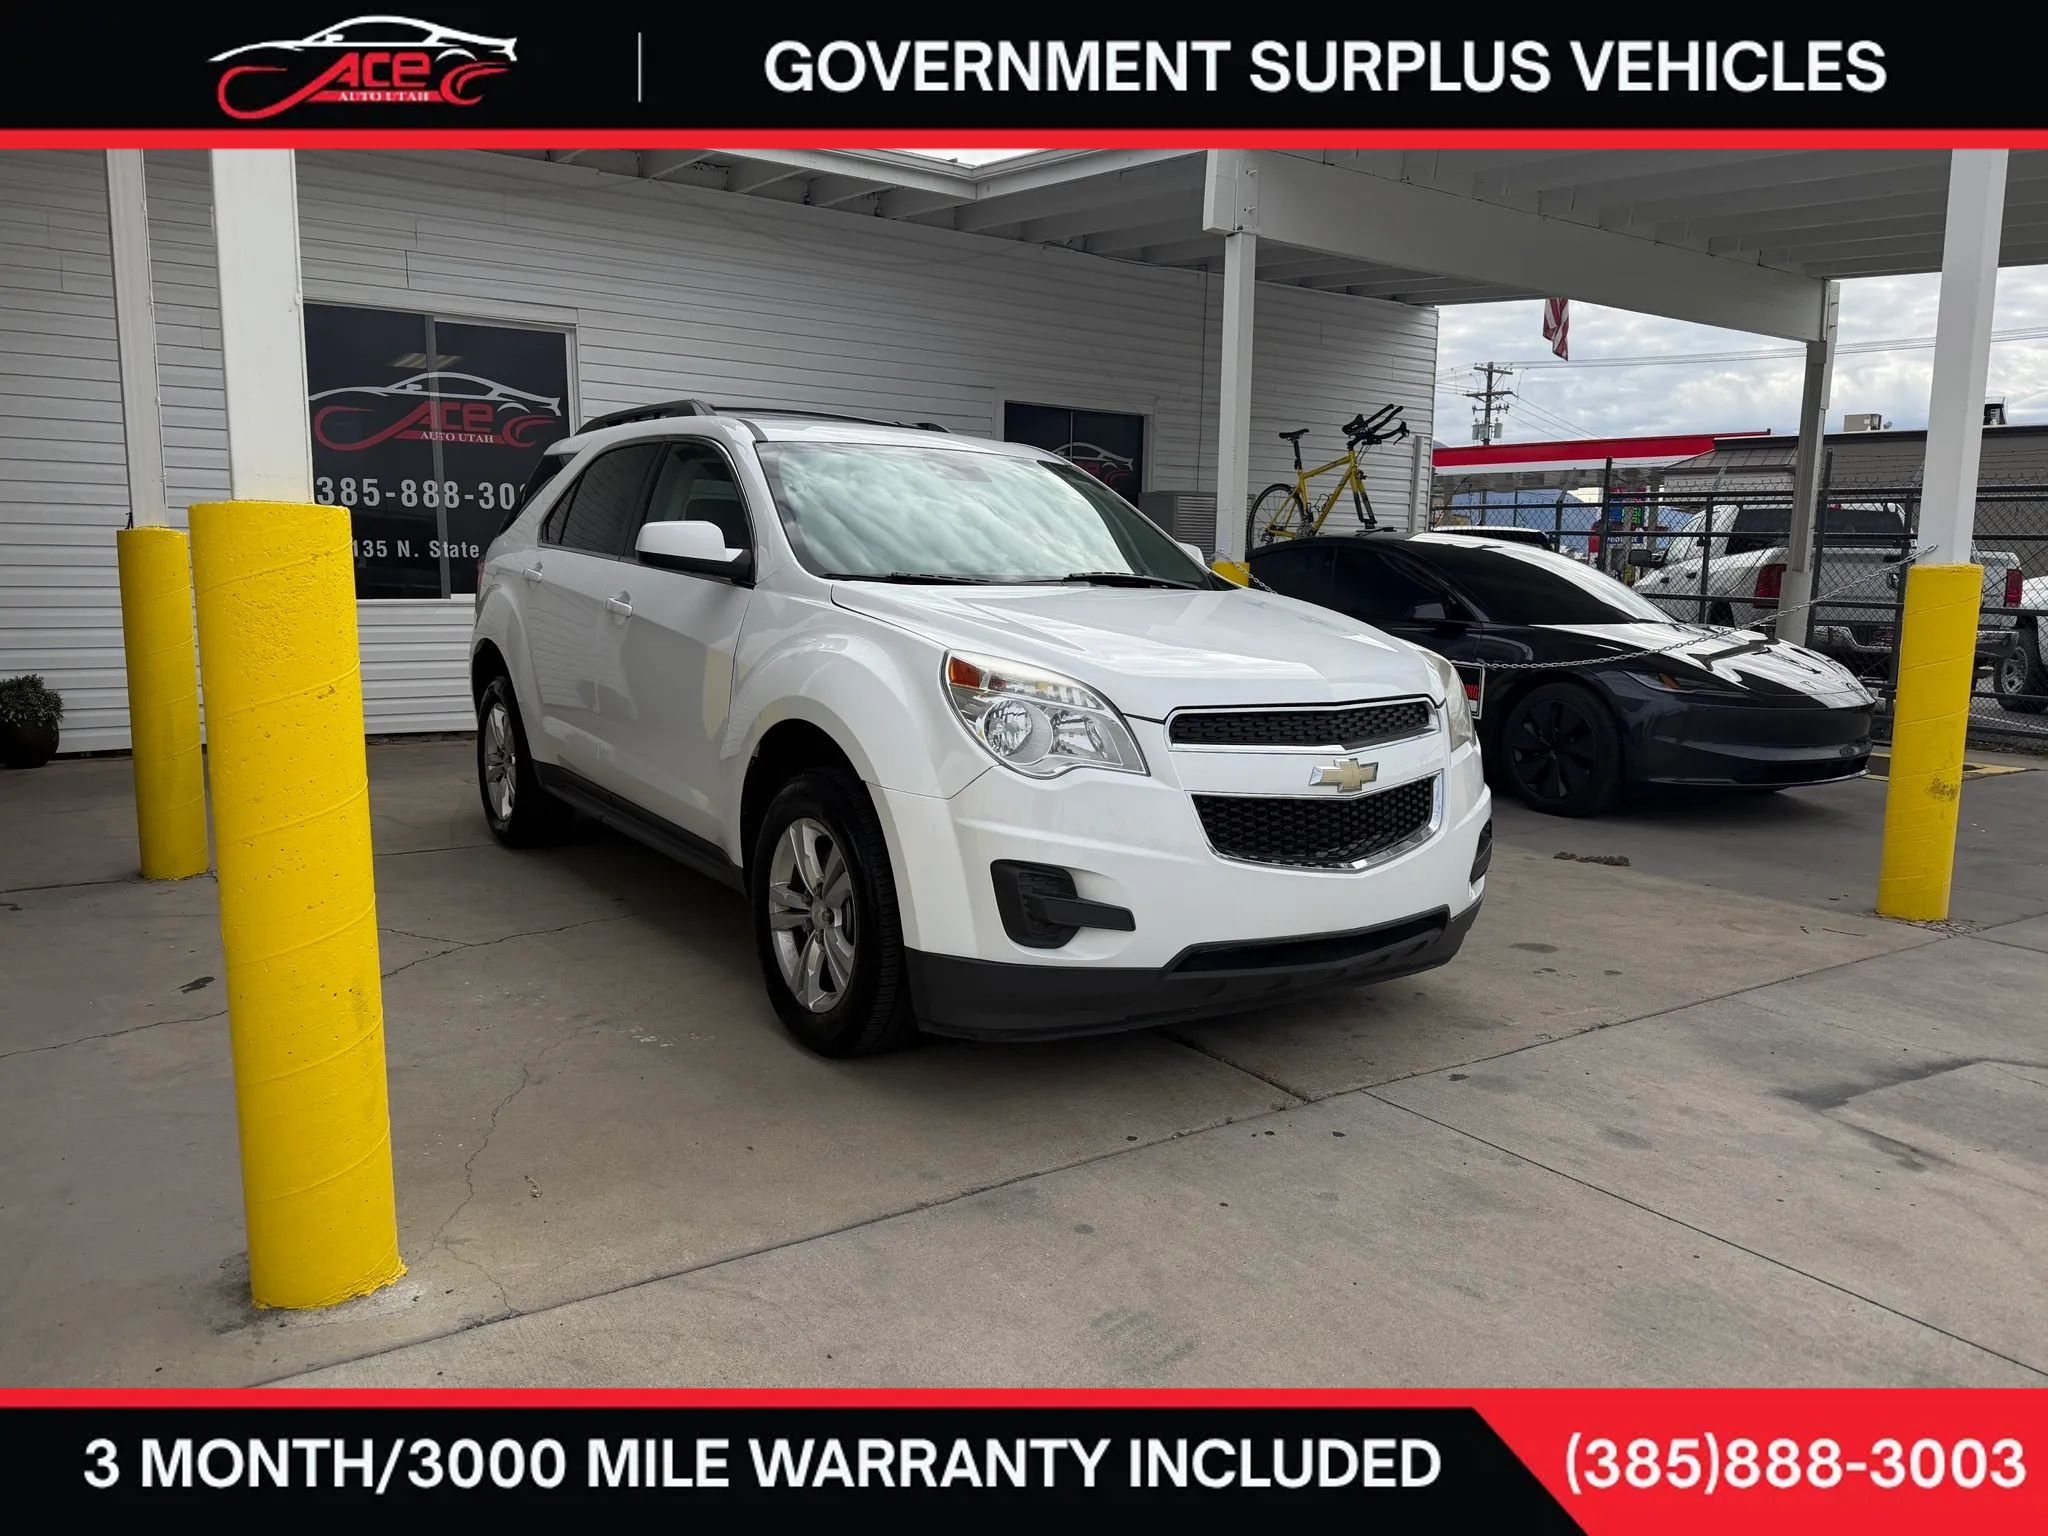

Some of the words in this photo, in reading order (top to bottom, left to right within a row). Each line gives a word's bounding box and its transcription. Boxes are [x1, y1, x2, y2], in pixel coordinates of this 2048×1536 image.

[420, 431, 456, 442] AUTO
[458, 433, 494, 444] UTAH
[397, 539, 419, 558] N.
[429, 540, 480, 558] State
